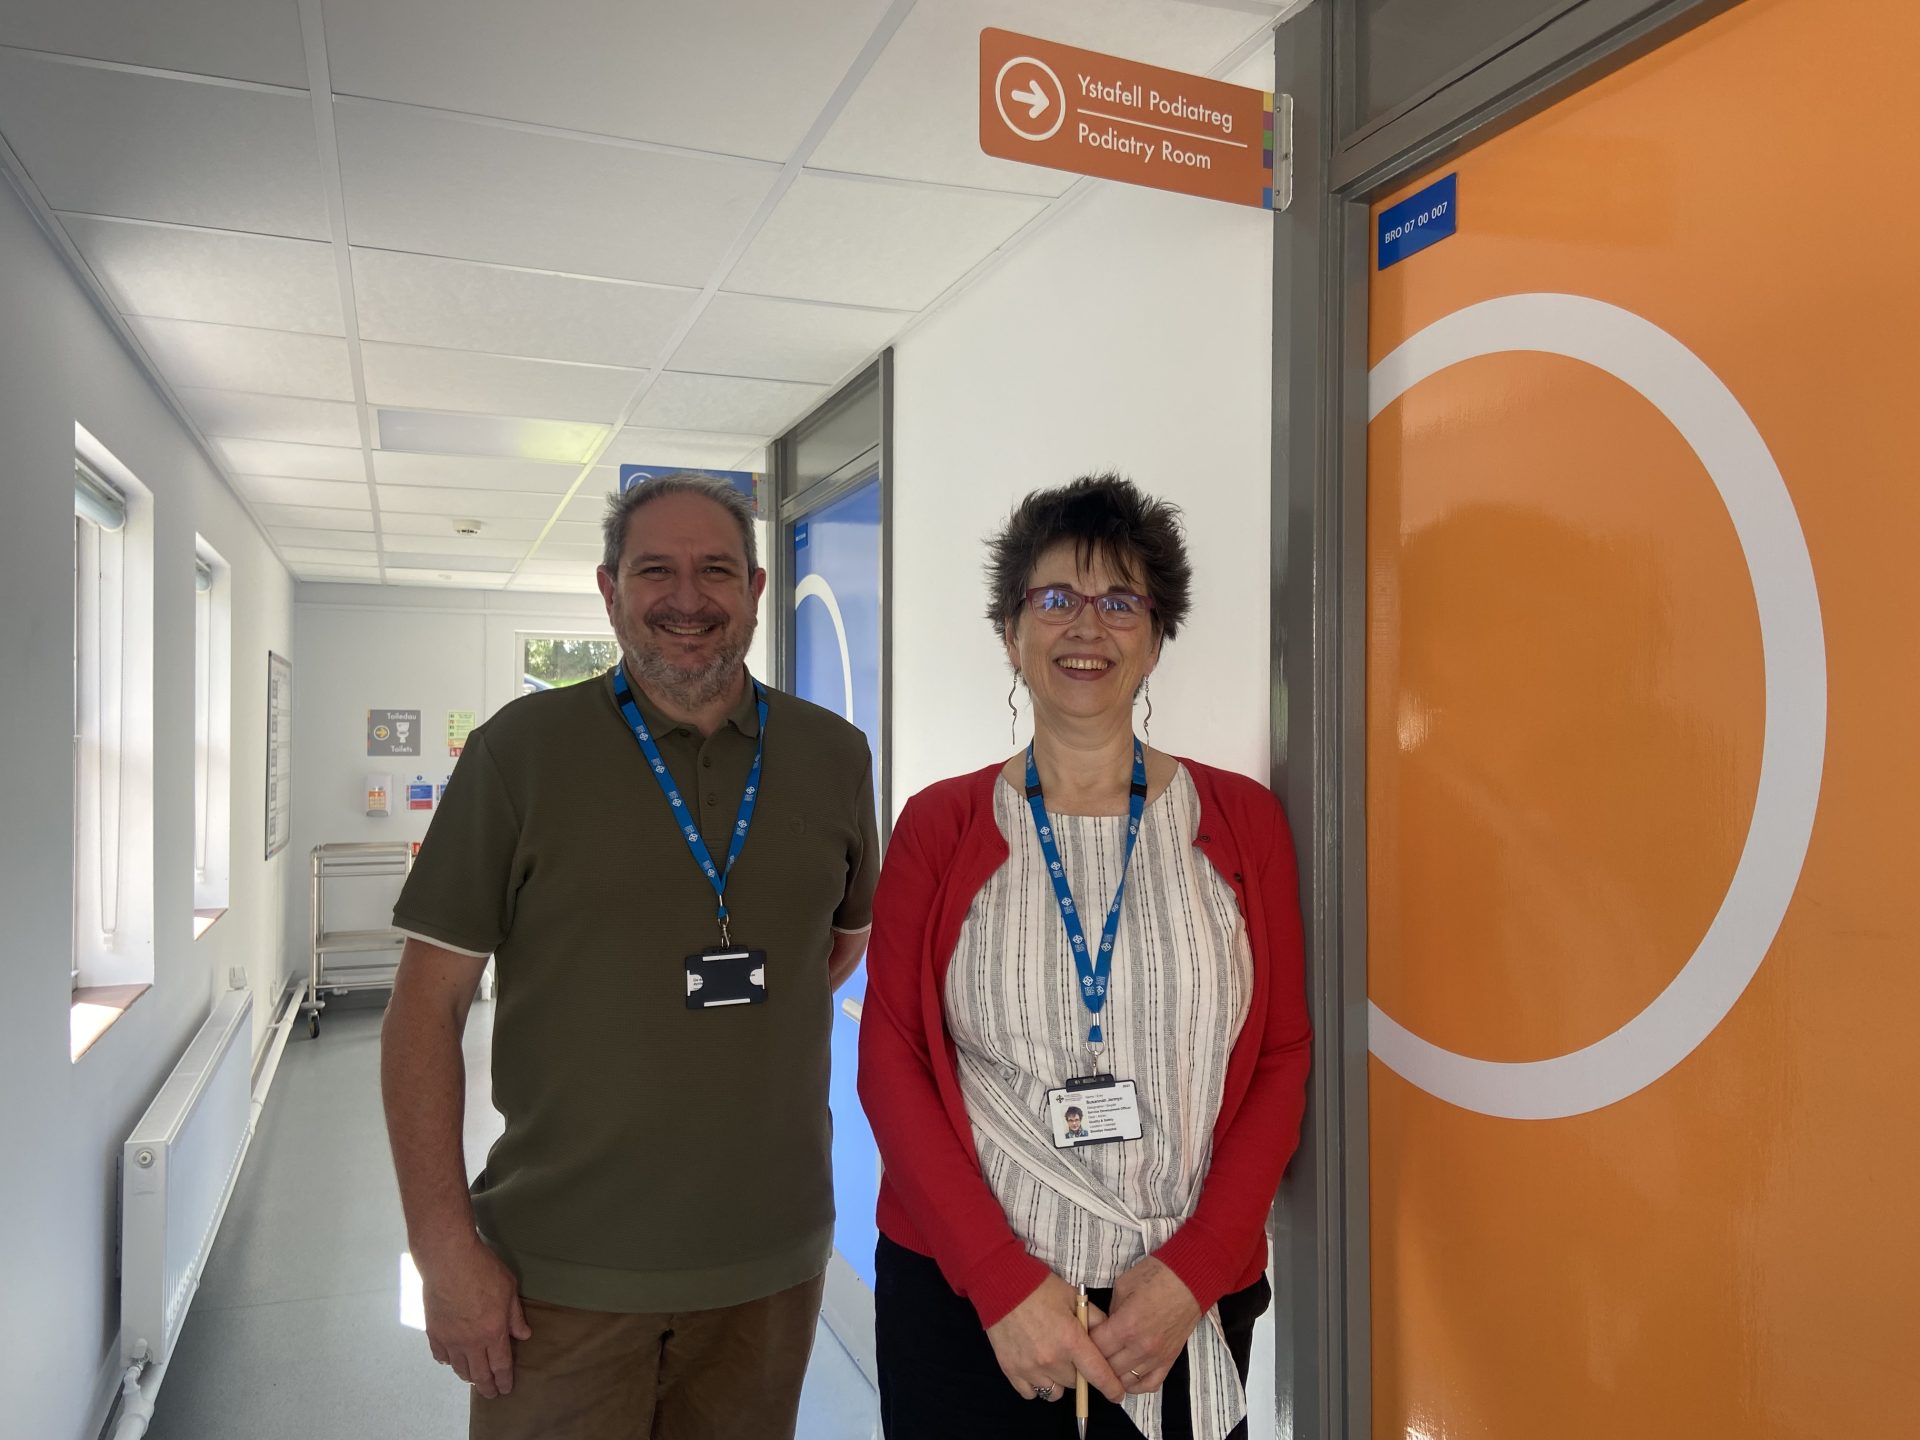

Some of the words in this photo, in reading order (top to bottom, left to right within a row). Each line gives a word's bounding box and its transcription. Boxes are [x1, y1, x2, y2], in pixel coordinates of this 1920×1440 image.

[1077, 73, 1142, 109] Ystafell
[1149, 90, 1233, 133] Podiatreg
[1078, 122, 1154, 163] Podiatry
[1162, 140, 1211, 169] Room
[1385, 226, 1402, 243] BRO
[1404, 219, 1415, 233] 07
[1417, 212, 1428, 226] 00
[1431, 201, 1448, 219] 007
[387, 712, 416, 720] Toiledau
[391, 745, 412, 753] Toilets
